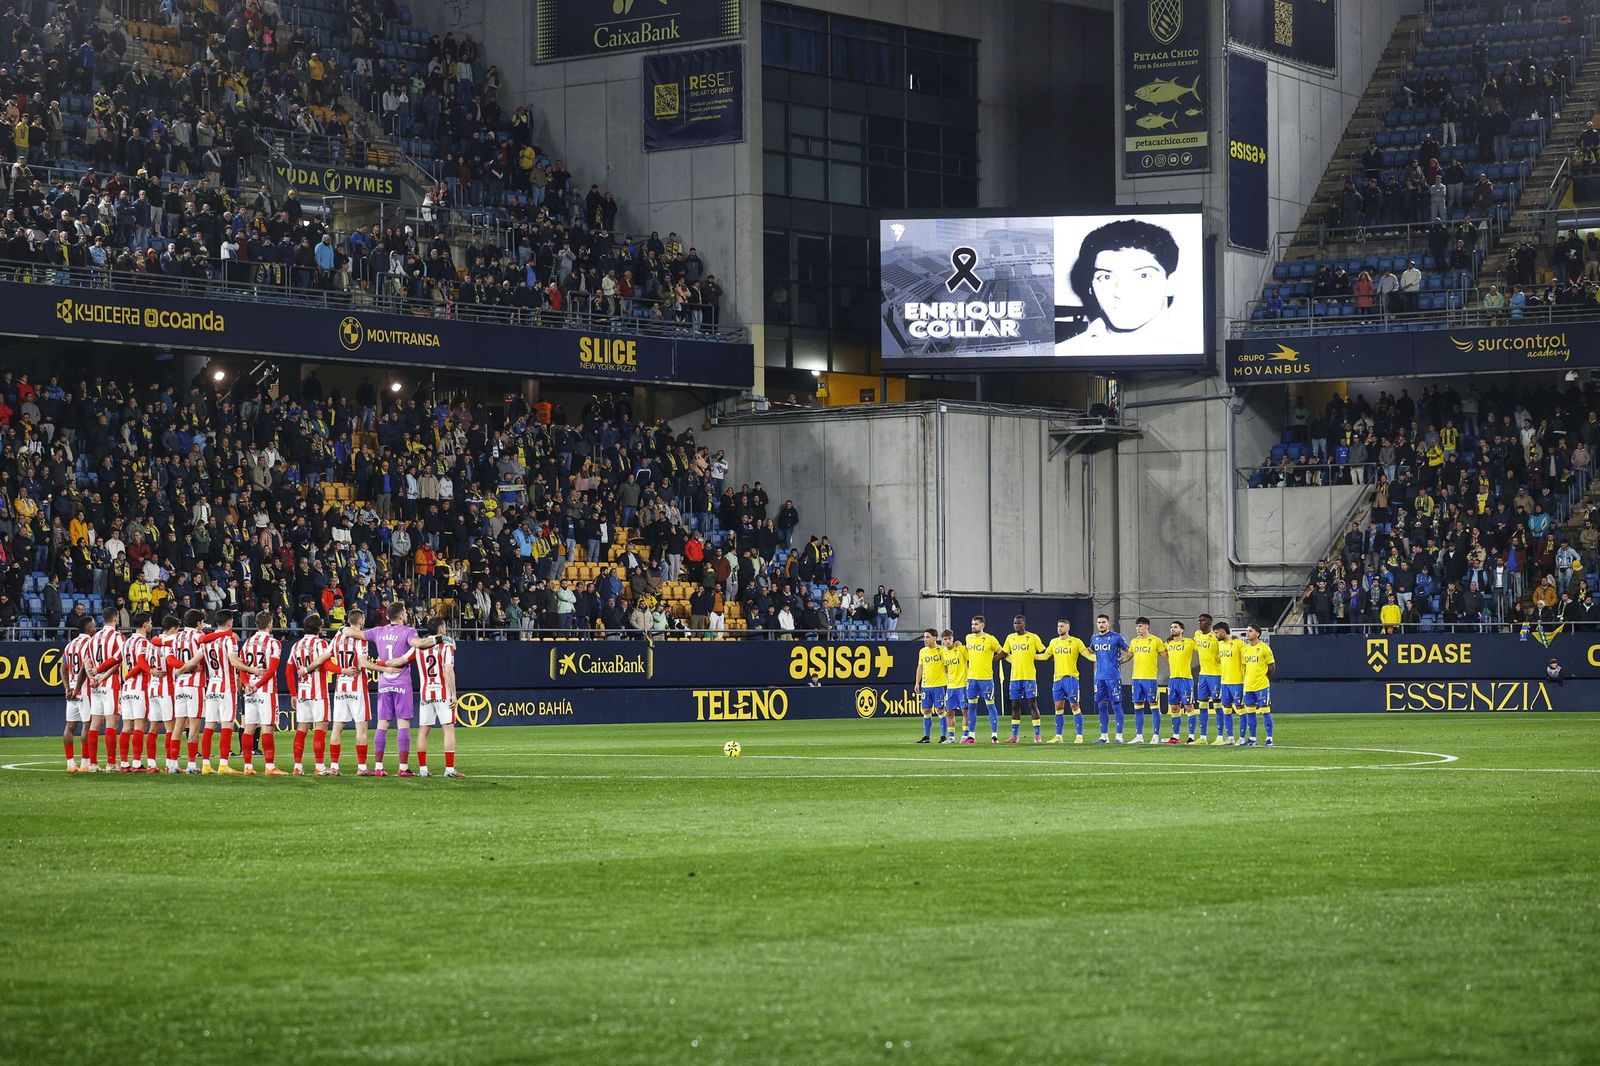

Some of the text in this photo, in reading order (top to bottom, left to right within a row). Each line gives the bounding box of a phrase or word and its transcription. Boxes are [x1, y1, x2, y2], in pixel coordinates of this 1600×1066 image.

[593, 19, 681, 48] CaixaBank
[1133, 49, 1199, 61] PETACA CHICO
[690, 70, 734, 90] RESET
[718, 86, 734, 94] BODY
[1135, 135, 1198, 150] petacachico.com
[344, 175, 393, 194] PYMES
[74, 303, 225, 332] KYOCERA coanda
[904, 301, 1024, 321] ENRIQUE
[908, 319, 1020, 338] COLLAR
[367, 329, 441, 347] MOVITRANSA
[579, 336, 637, 366] SLICE
[1238, 354, 1265, 362] GRUPO
[1527, 346, 1571, 361] academy
[580, 362, 637, 373] NEW YORK PIZZA
[1234, 364, 1311, 376] MOVANBUS
[96, 645, 104, 664] 4
[385, 644, 393, 660] 1
[968, 644, 985, 652] DIGI
[1012, 643, 1030, 651] DIGI
[1094, 643, 1111, 651] DIGI
[1397, 643, 1472, 664] EDASE
[68, 652, 81, 675] 19
[126, 654, 133, 672] 5
[208, 648, 220, 671] 8
[338, 650, 355, 669] 17
[426, 655, 438, 678] 2
[579, 653, 646, 675] CaixaBank
[924, 654, 942, 663] DIGI
[945, 658, 960, 666] DIGI
[692, 689, 789, 721] TELENO
[1386, 682, 1553, 711] ESSENZIA
[497, 698, 574, 716] GAMO BAHÍA
